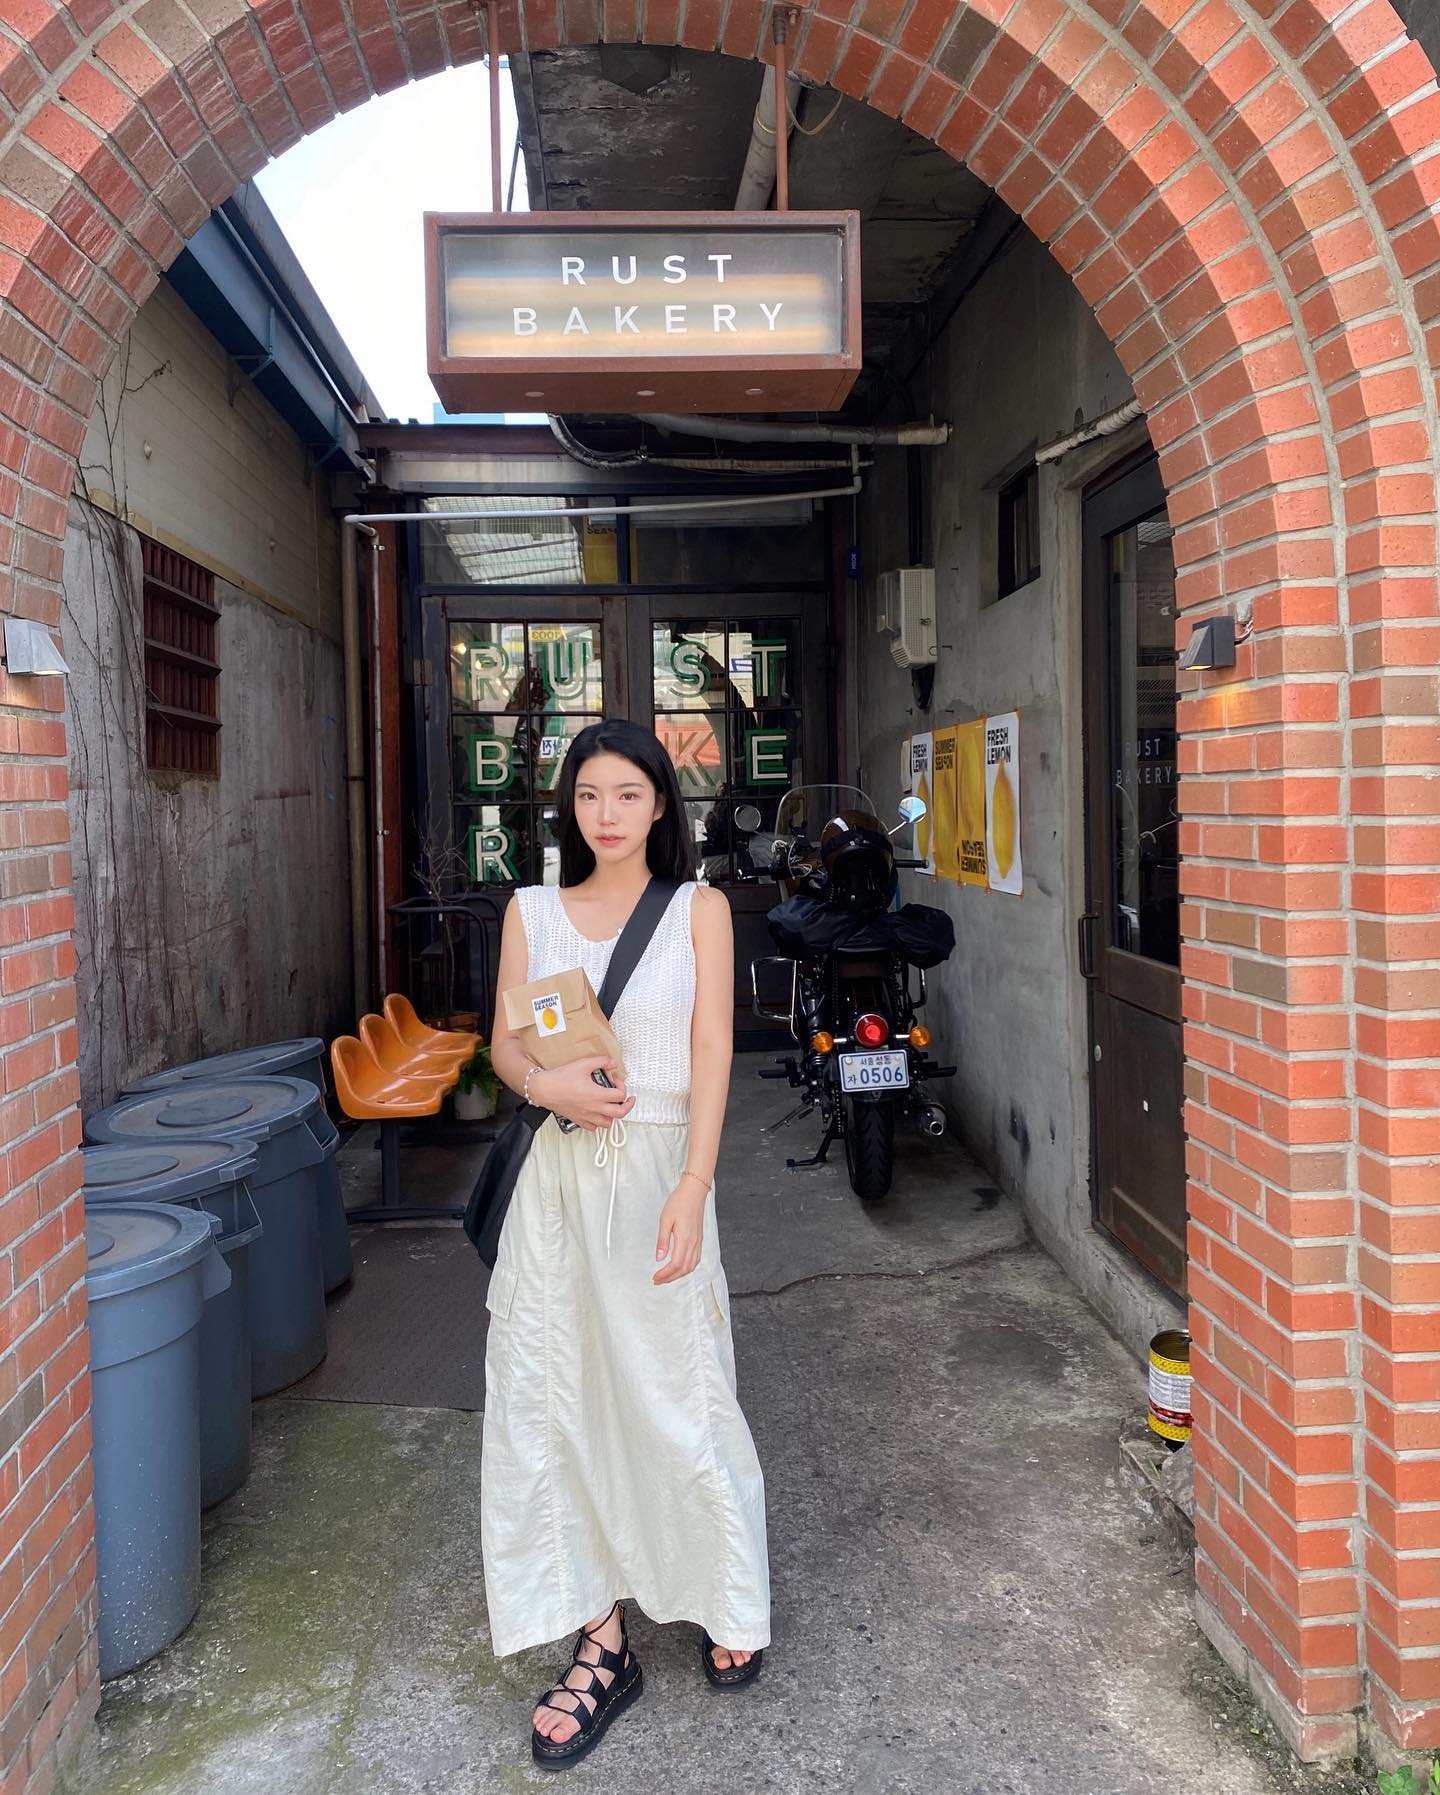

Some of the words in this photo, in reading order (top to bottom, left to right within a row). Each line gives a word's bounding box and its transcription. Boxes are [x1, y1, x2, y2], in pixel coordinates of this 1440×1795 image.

[561, 254, 733, 286] RUST
[512, 302, 783, 337] BAKERY
[464, 638, 788, 702] RUST
[987, 727, 1009, 747] FRESH
[913, 743, 927, 758] FRESH
[987, 745, 1011, 765] LEMON
[534, 996, 558, 1006] SUMMER
[535, 1002, 556, 1011] SEASON
[860, 1066, 904, 1085] 0506
